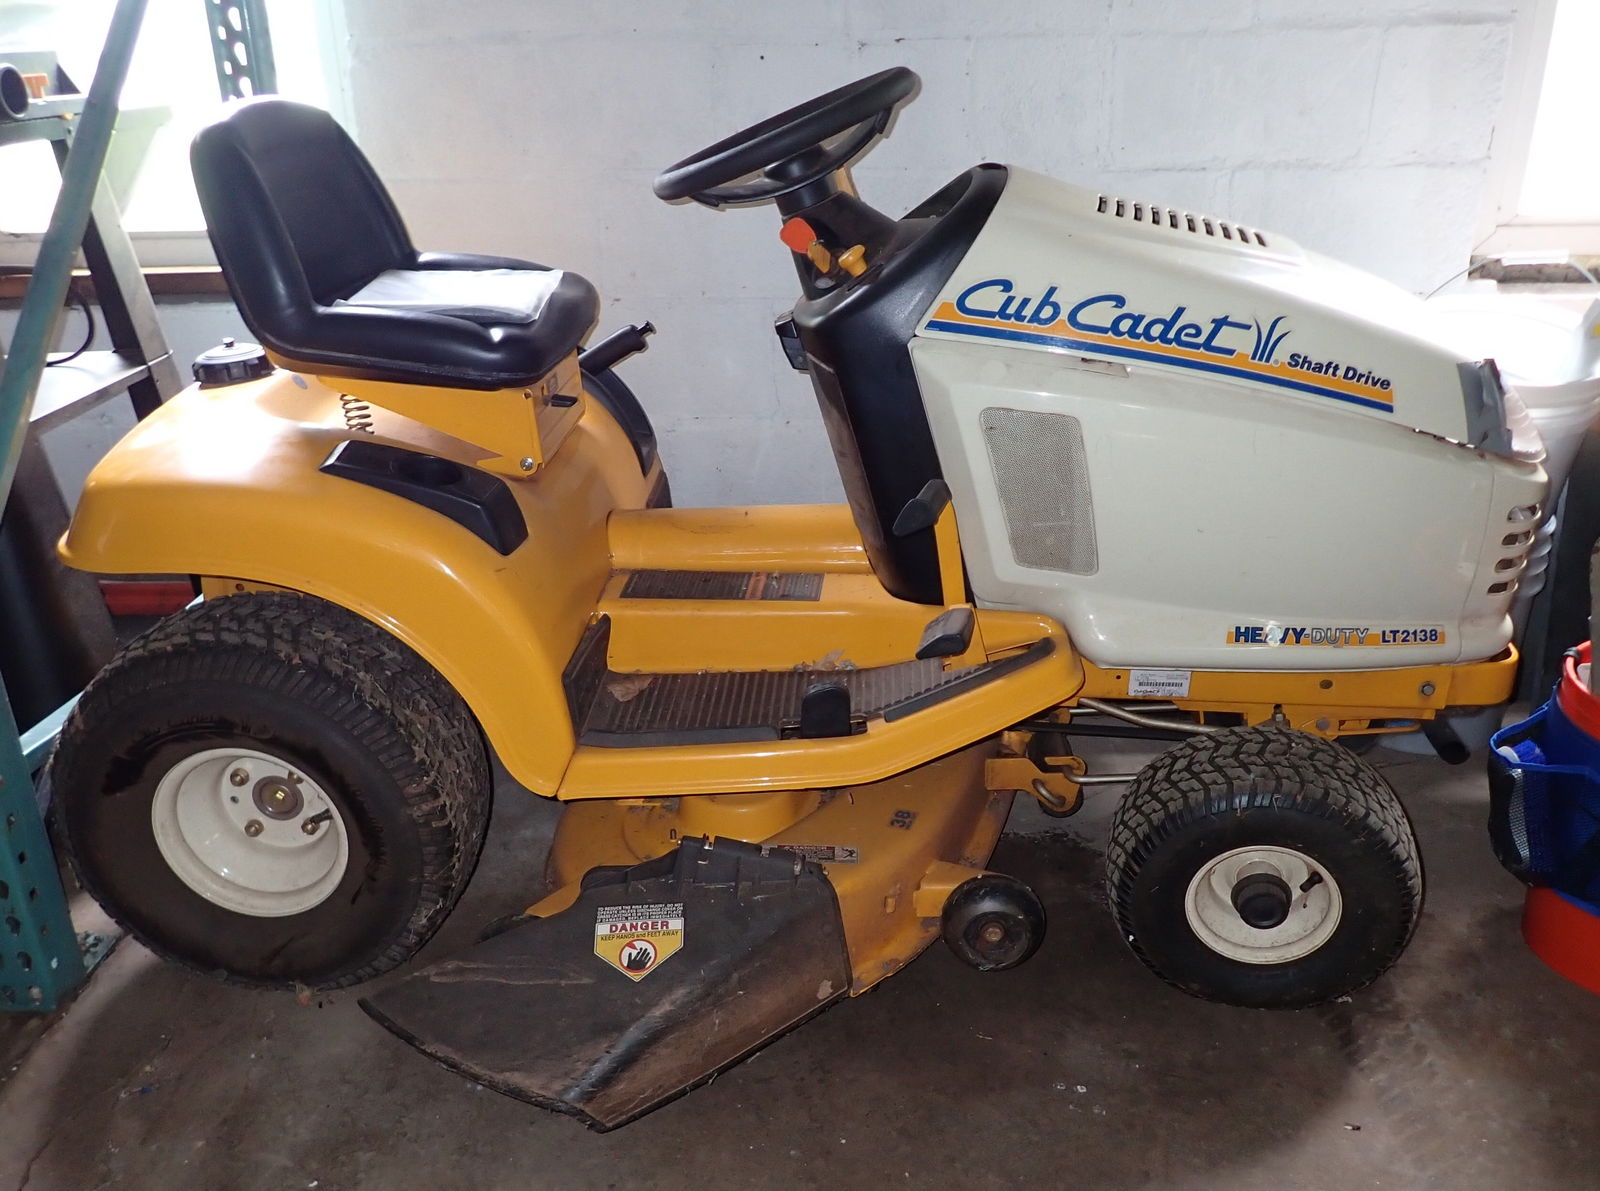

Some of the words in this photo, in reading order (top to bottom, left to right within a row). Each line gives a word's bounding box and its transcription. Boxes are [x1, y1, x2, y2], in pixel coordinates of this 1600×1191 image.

[955, 279, 1060, 327] Cub
[1067, 294, 1252, 356] Cadet
[1287, 353, 1340, 377] Shaft
[1342, 366, 1391, 390] Drive
[1381, 629, 1438, 643] LT2138
[609, 921, 670, 933] DANGER
[615, 932, 636, 940] HANDS
